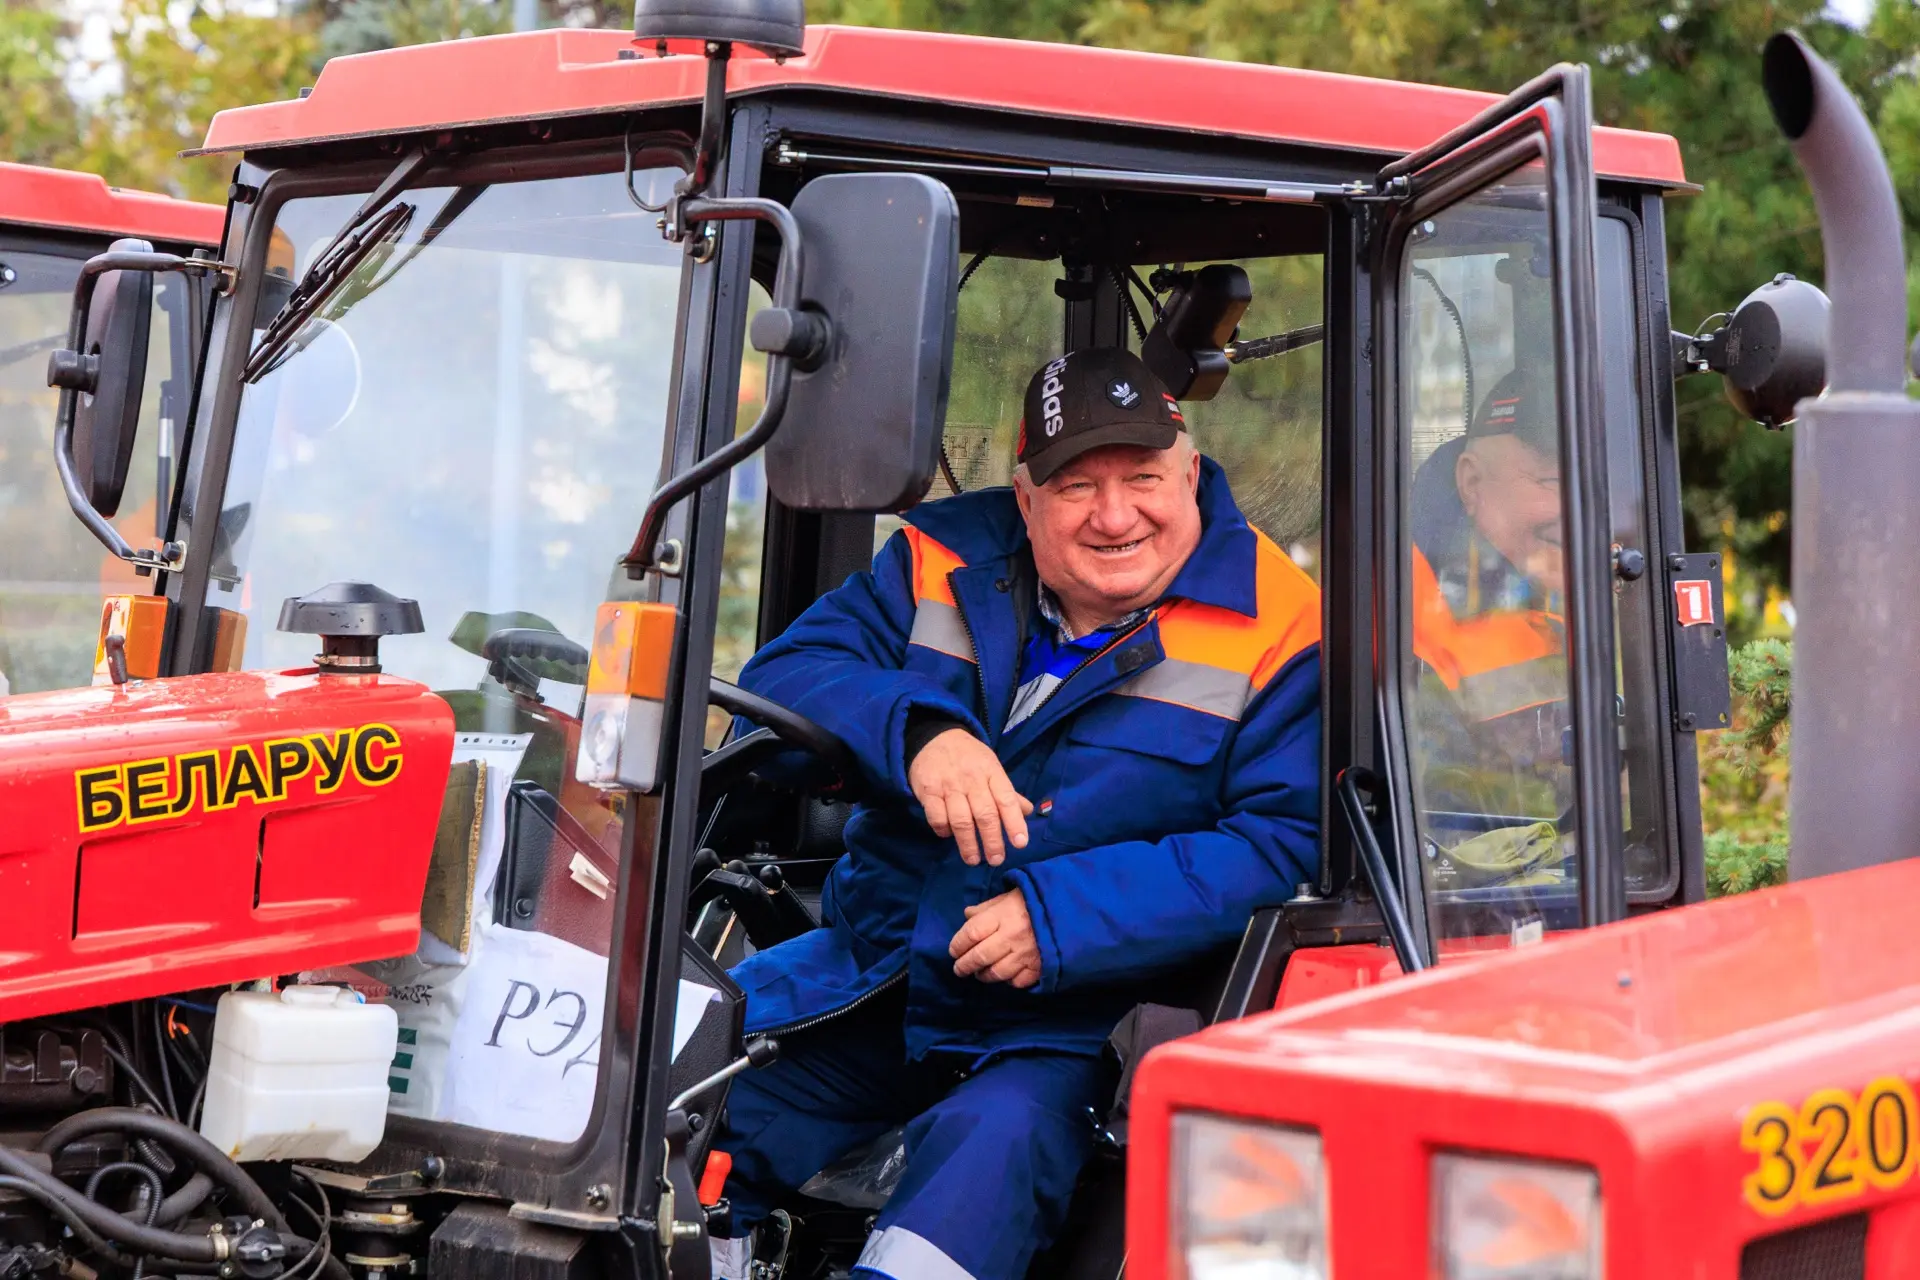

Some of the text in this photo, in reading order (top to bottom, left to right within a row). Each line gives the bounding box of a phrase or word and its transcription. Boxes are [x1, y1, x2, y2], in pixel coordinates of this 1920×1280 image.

[1042, 352, 1075, 437] didas
[1121, 392, 1139, 406] adidas
[75, 723, 403, 832] БЕЛАРУС
[1741, 1079, 1916, 1215] 320
